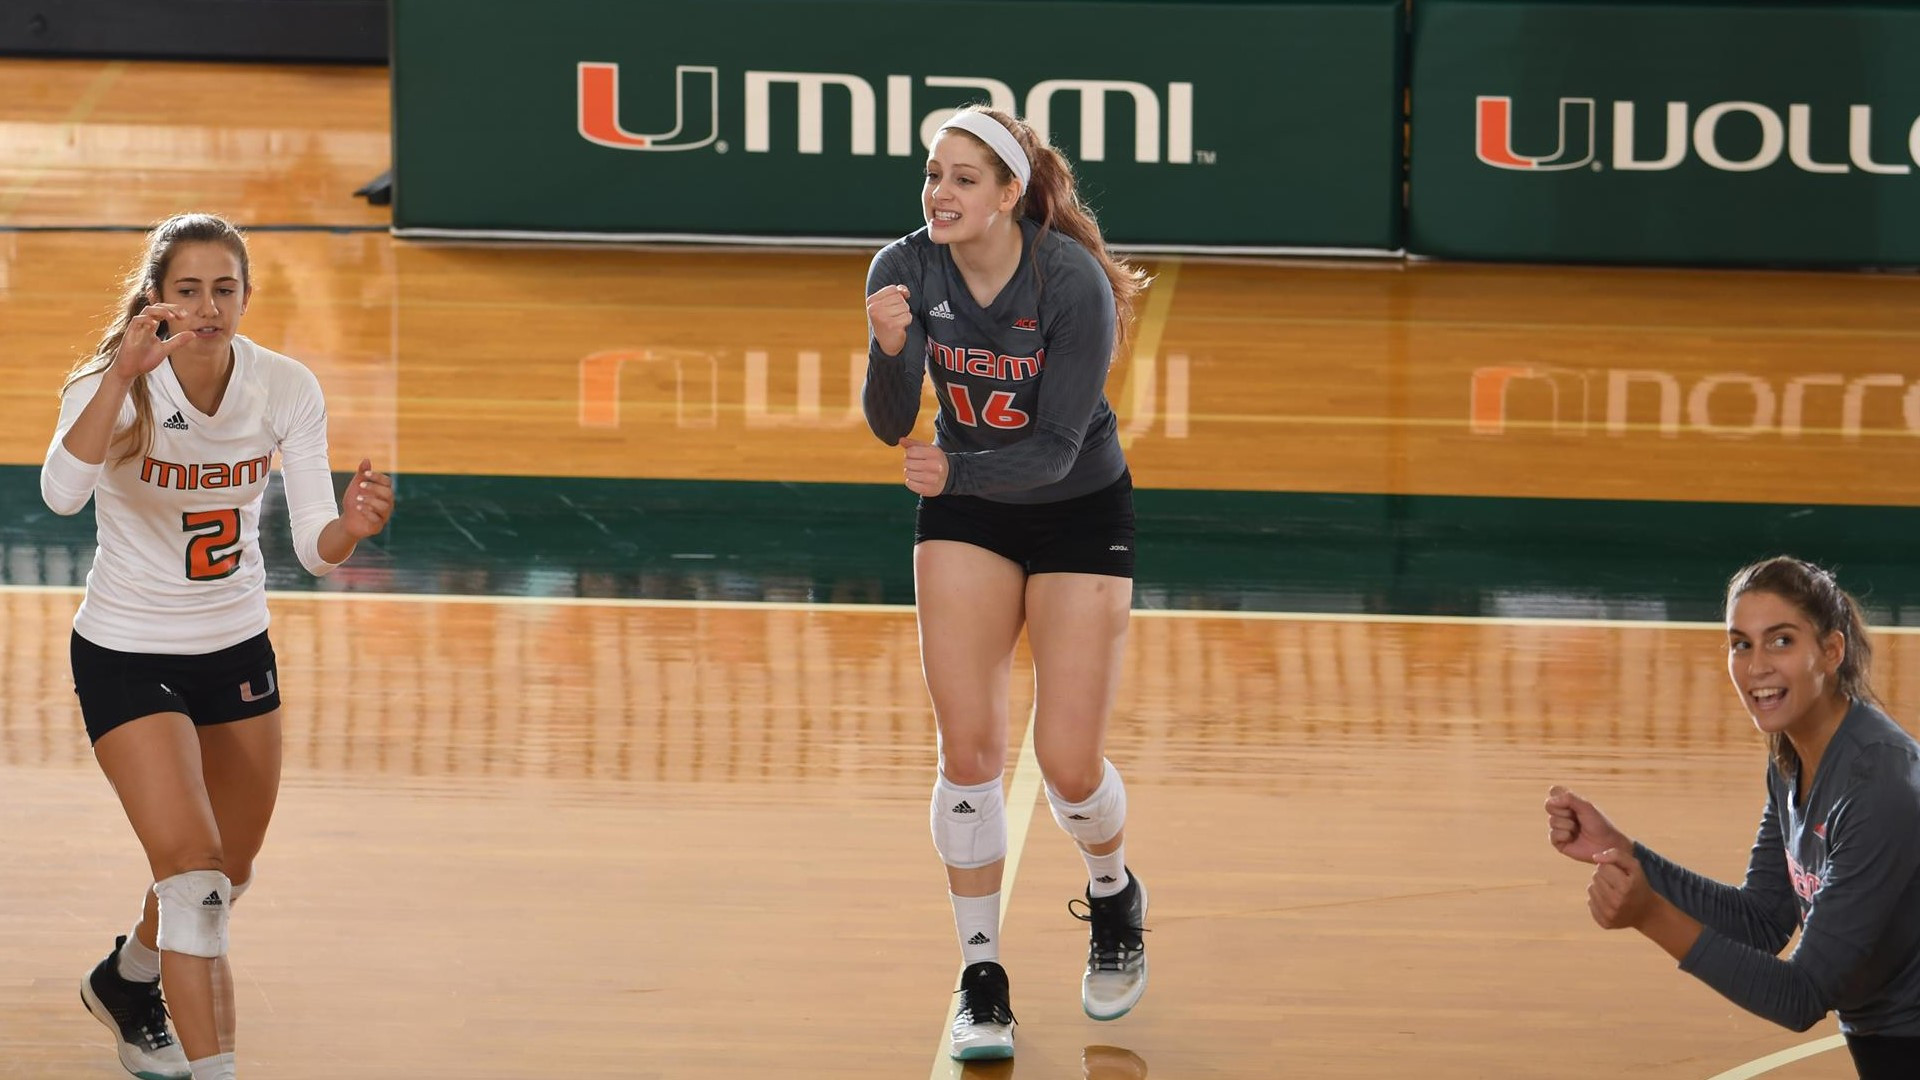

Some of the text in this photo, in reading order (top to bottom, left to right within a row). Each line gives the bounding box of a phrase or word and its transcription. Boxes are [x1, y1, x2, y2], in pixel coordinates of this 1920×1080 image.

[577, 61, 719, 152] U
[1476, 95, 1920, 174] U VOLL
[163, 421, 188, 430] adidas
[947, 381, 1030, 430] 16
[140, 449, 272, 490] MIAM
[182, 508, 243, 581] 2
